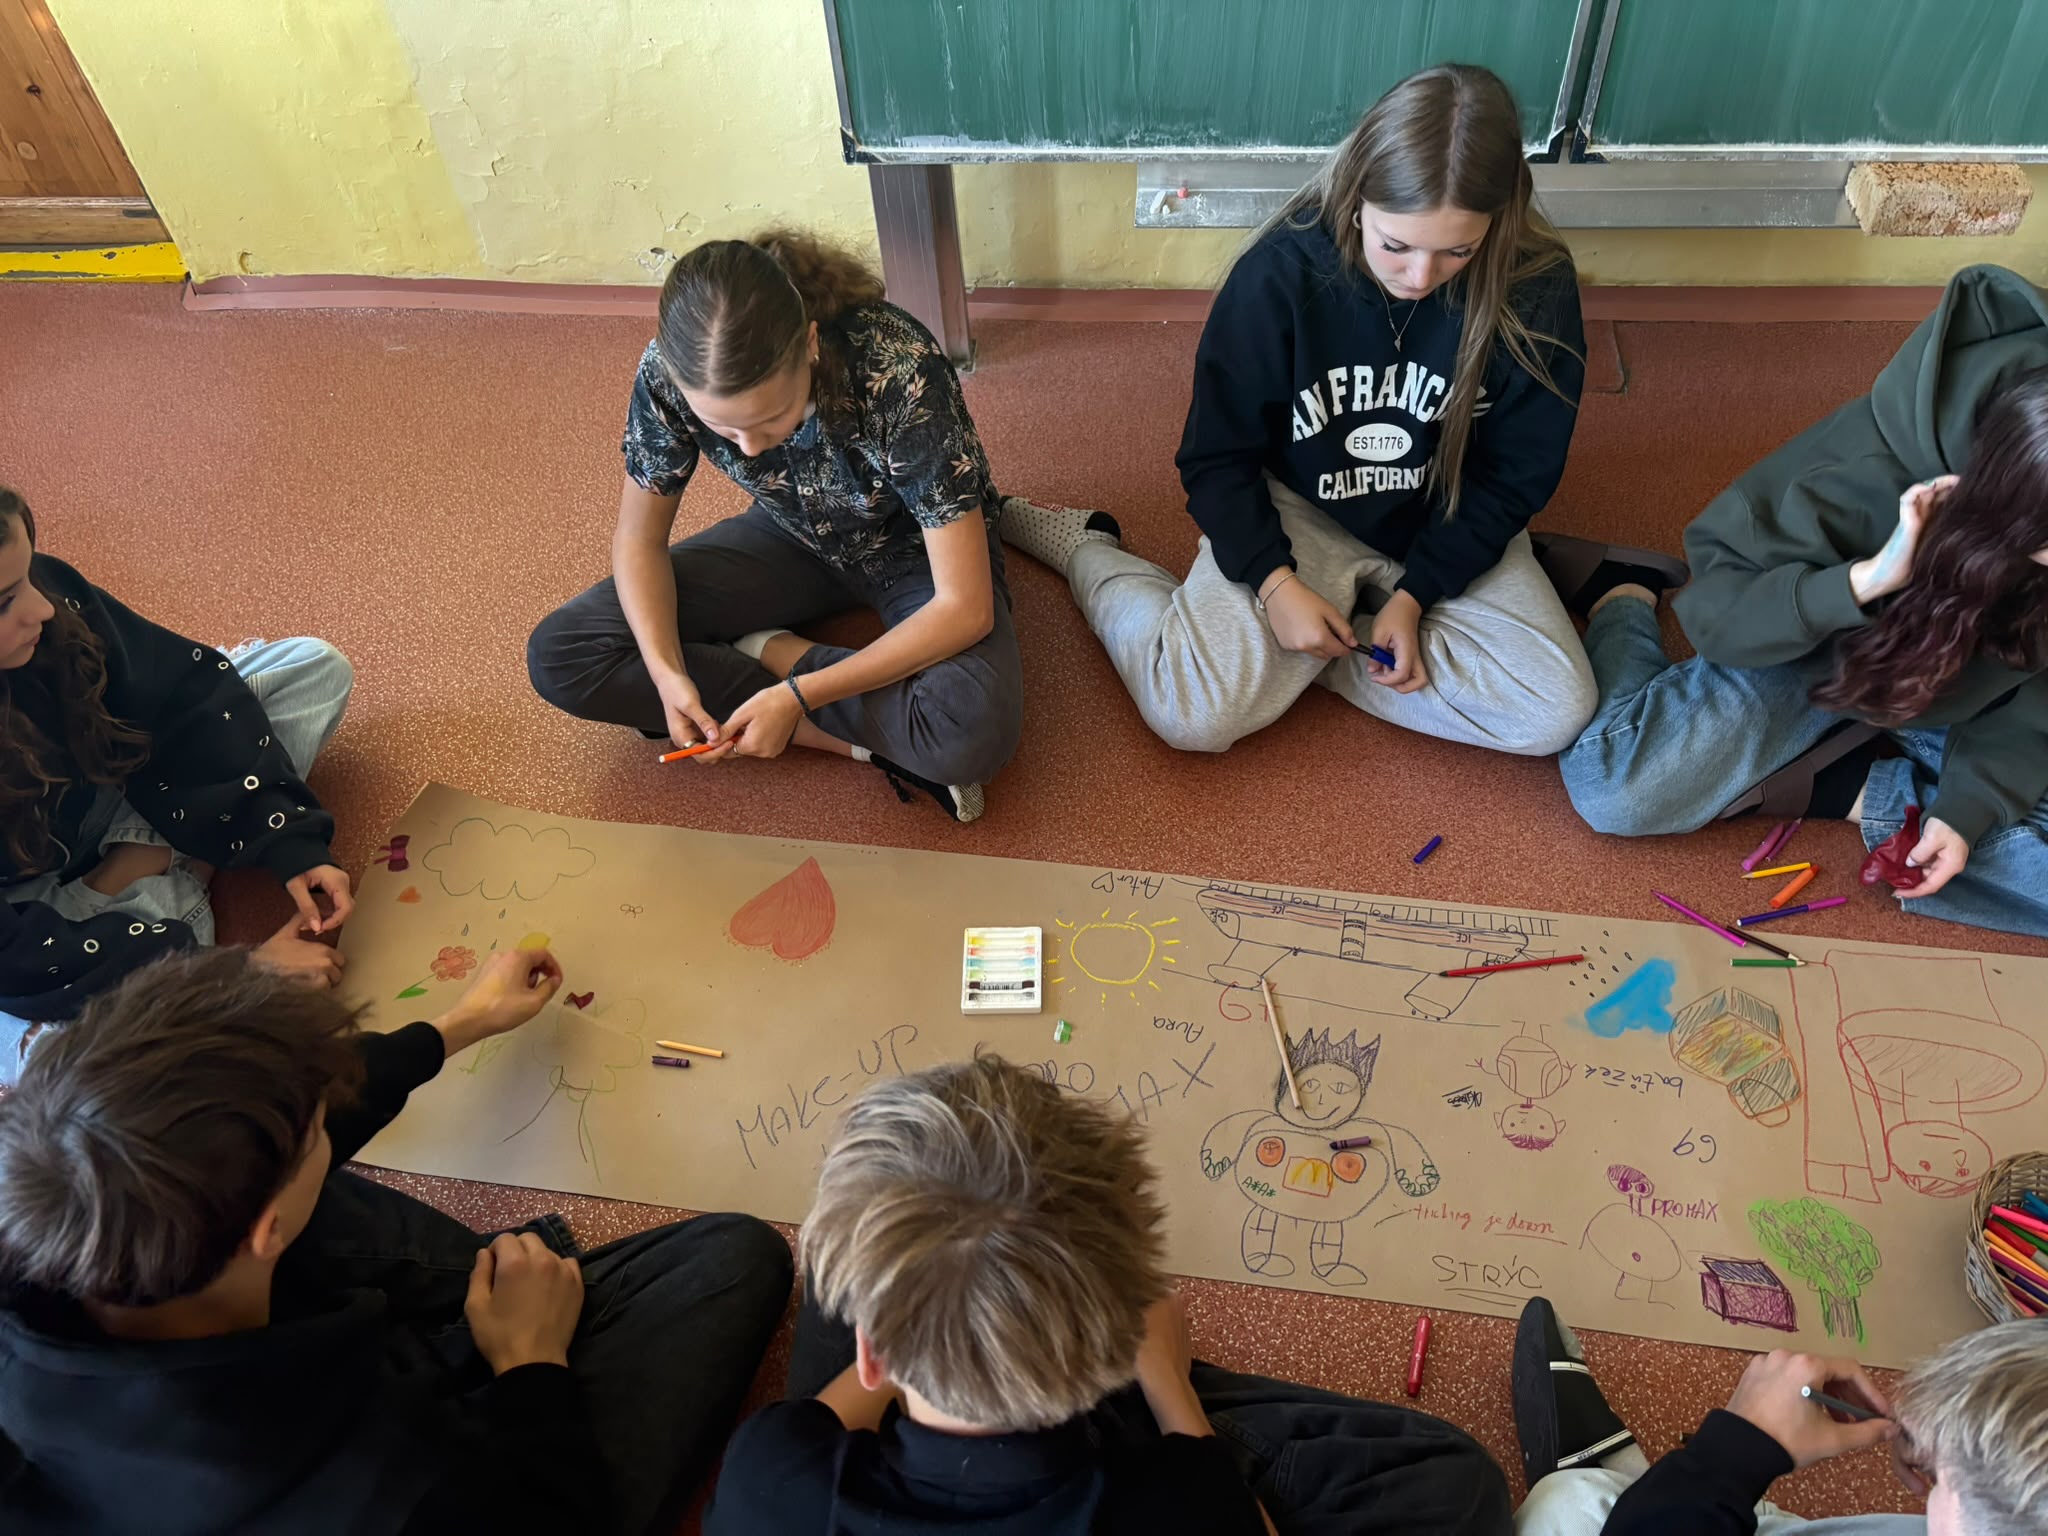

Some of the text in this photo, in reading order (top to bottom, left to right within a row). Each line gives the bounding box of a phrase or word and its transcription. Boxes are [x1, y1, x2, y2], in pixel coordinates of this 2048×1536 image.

[1117, 875, 1164, 899] Artur
[1456, 933, 1471, 943] ICE
[1432, 1255, 1543, 1289] STRÝC
